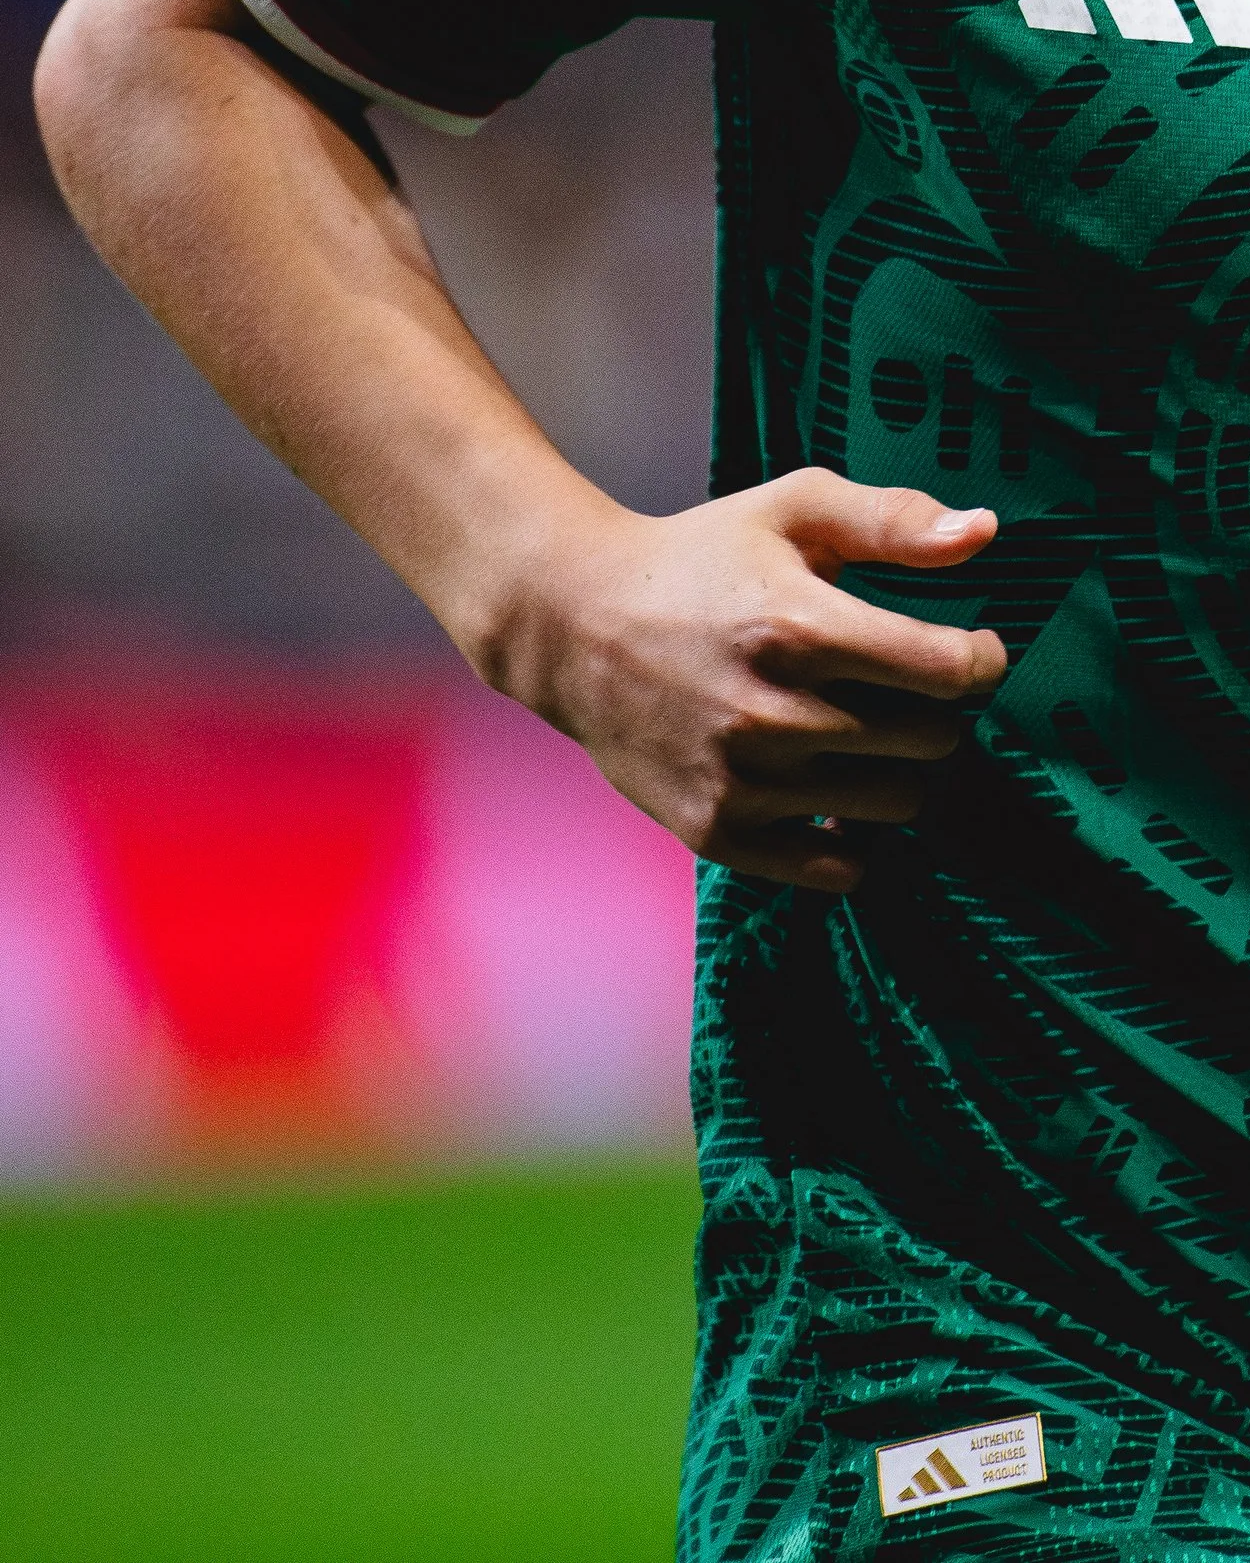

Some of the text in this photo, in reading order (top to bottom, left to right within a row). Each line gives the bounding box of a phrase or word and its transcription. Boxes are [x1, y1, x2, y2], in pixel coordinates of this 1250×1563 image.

[970, 1429, 1025, 1451] AUTHENTIC
[980, 1446, 1027, 1466] LICENSED
[983, 1462, 1028, 1483] PRODUCT
